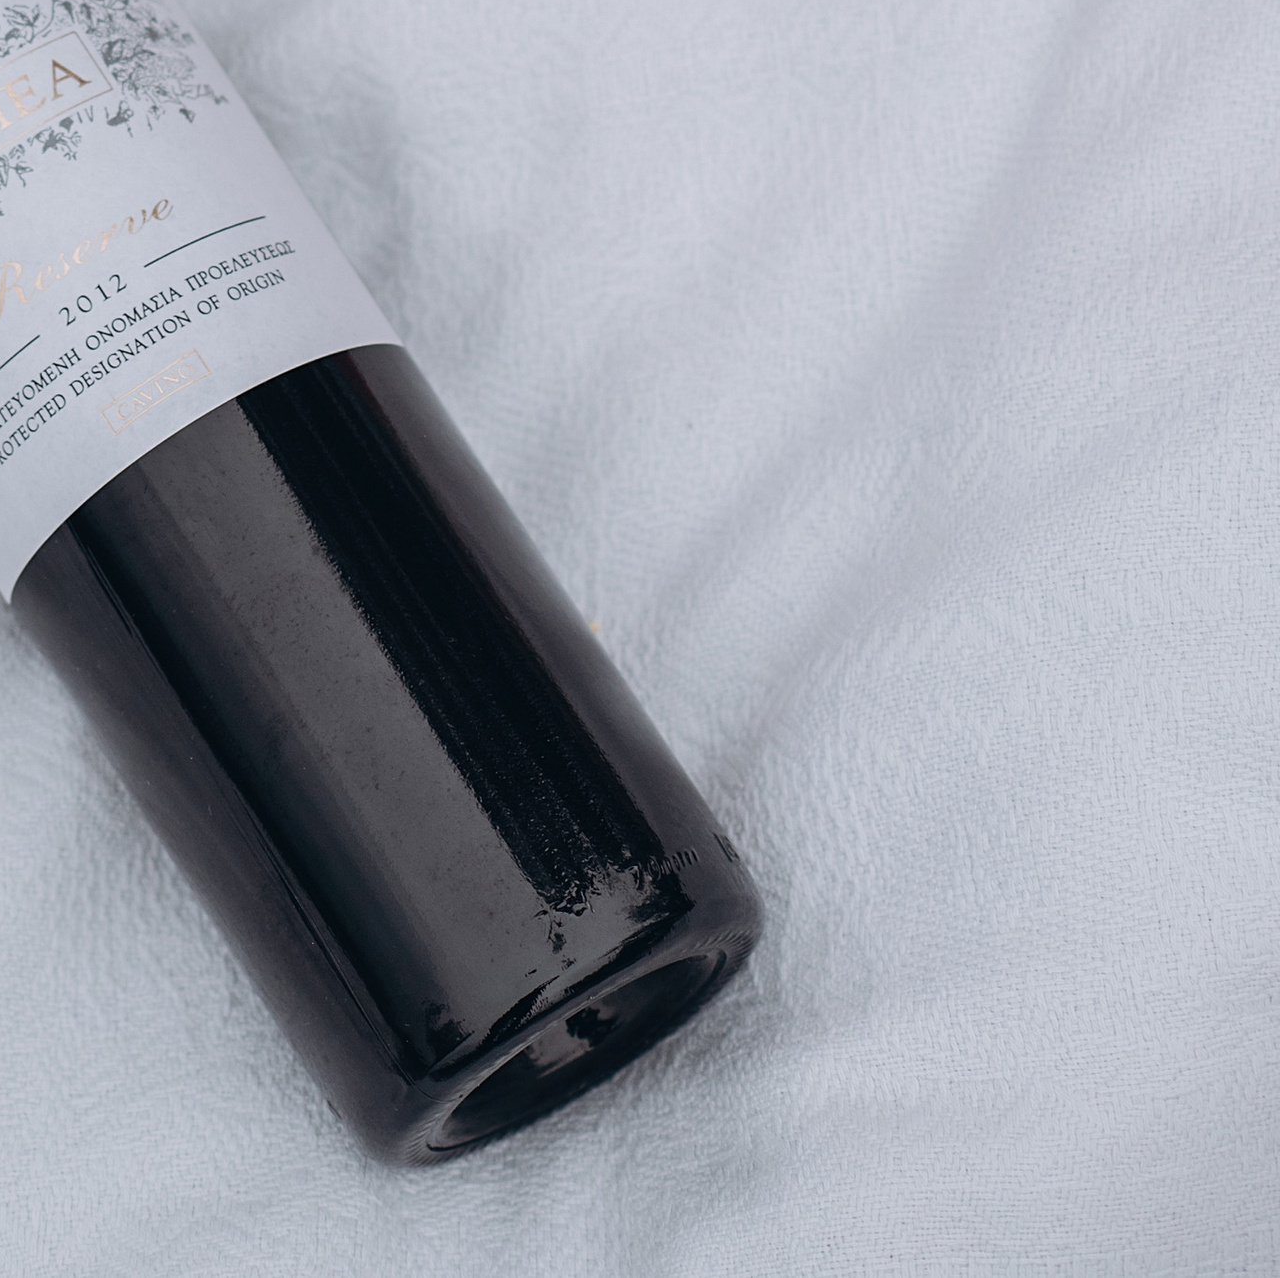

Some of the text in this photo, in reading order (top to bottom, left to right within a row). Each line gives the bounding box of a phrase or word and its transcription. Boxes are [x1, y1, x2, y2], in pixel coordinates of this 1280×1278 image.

[58, 274, 128, 327] 2012
[68, 310, 193, 398] DESIGNATION
[196, 294, 221, 316] OF
[226, 268, 287, 302] ORIGIN
[85, 287, 184, 352] ΟΝΟΜΑΣΙΑ
[184, 239, 296, 292] ΠΡΟΕΛΕΥΣΕΩΣ
[115, 361, 197, 421] CAVINO
